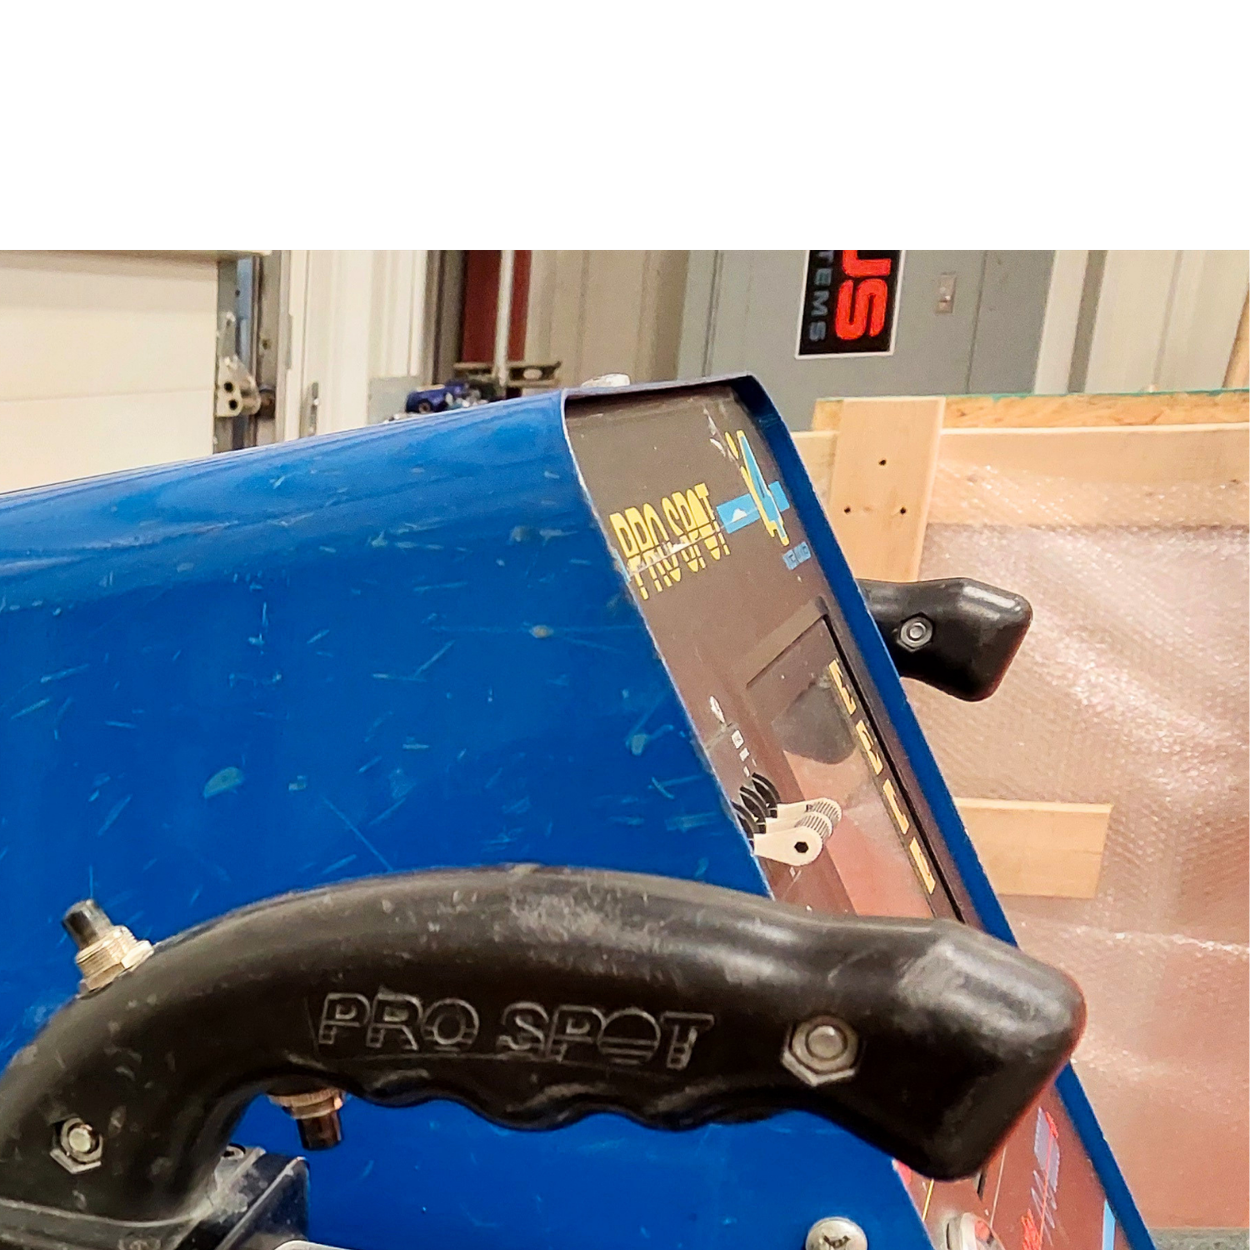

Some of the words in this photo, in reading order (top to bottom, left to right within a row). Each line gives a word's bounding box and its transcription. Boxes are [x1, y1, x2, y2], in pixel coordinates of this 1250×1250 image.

[609, 502, 682, 600] PRO
[661, 482, 731, 573] SPOT
[317, 989, 480, 1055] PRO
[495, 1001, 716, 1070] SPOT
